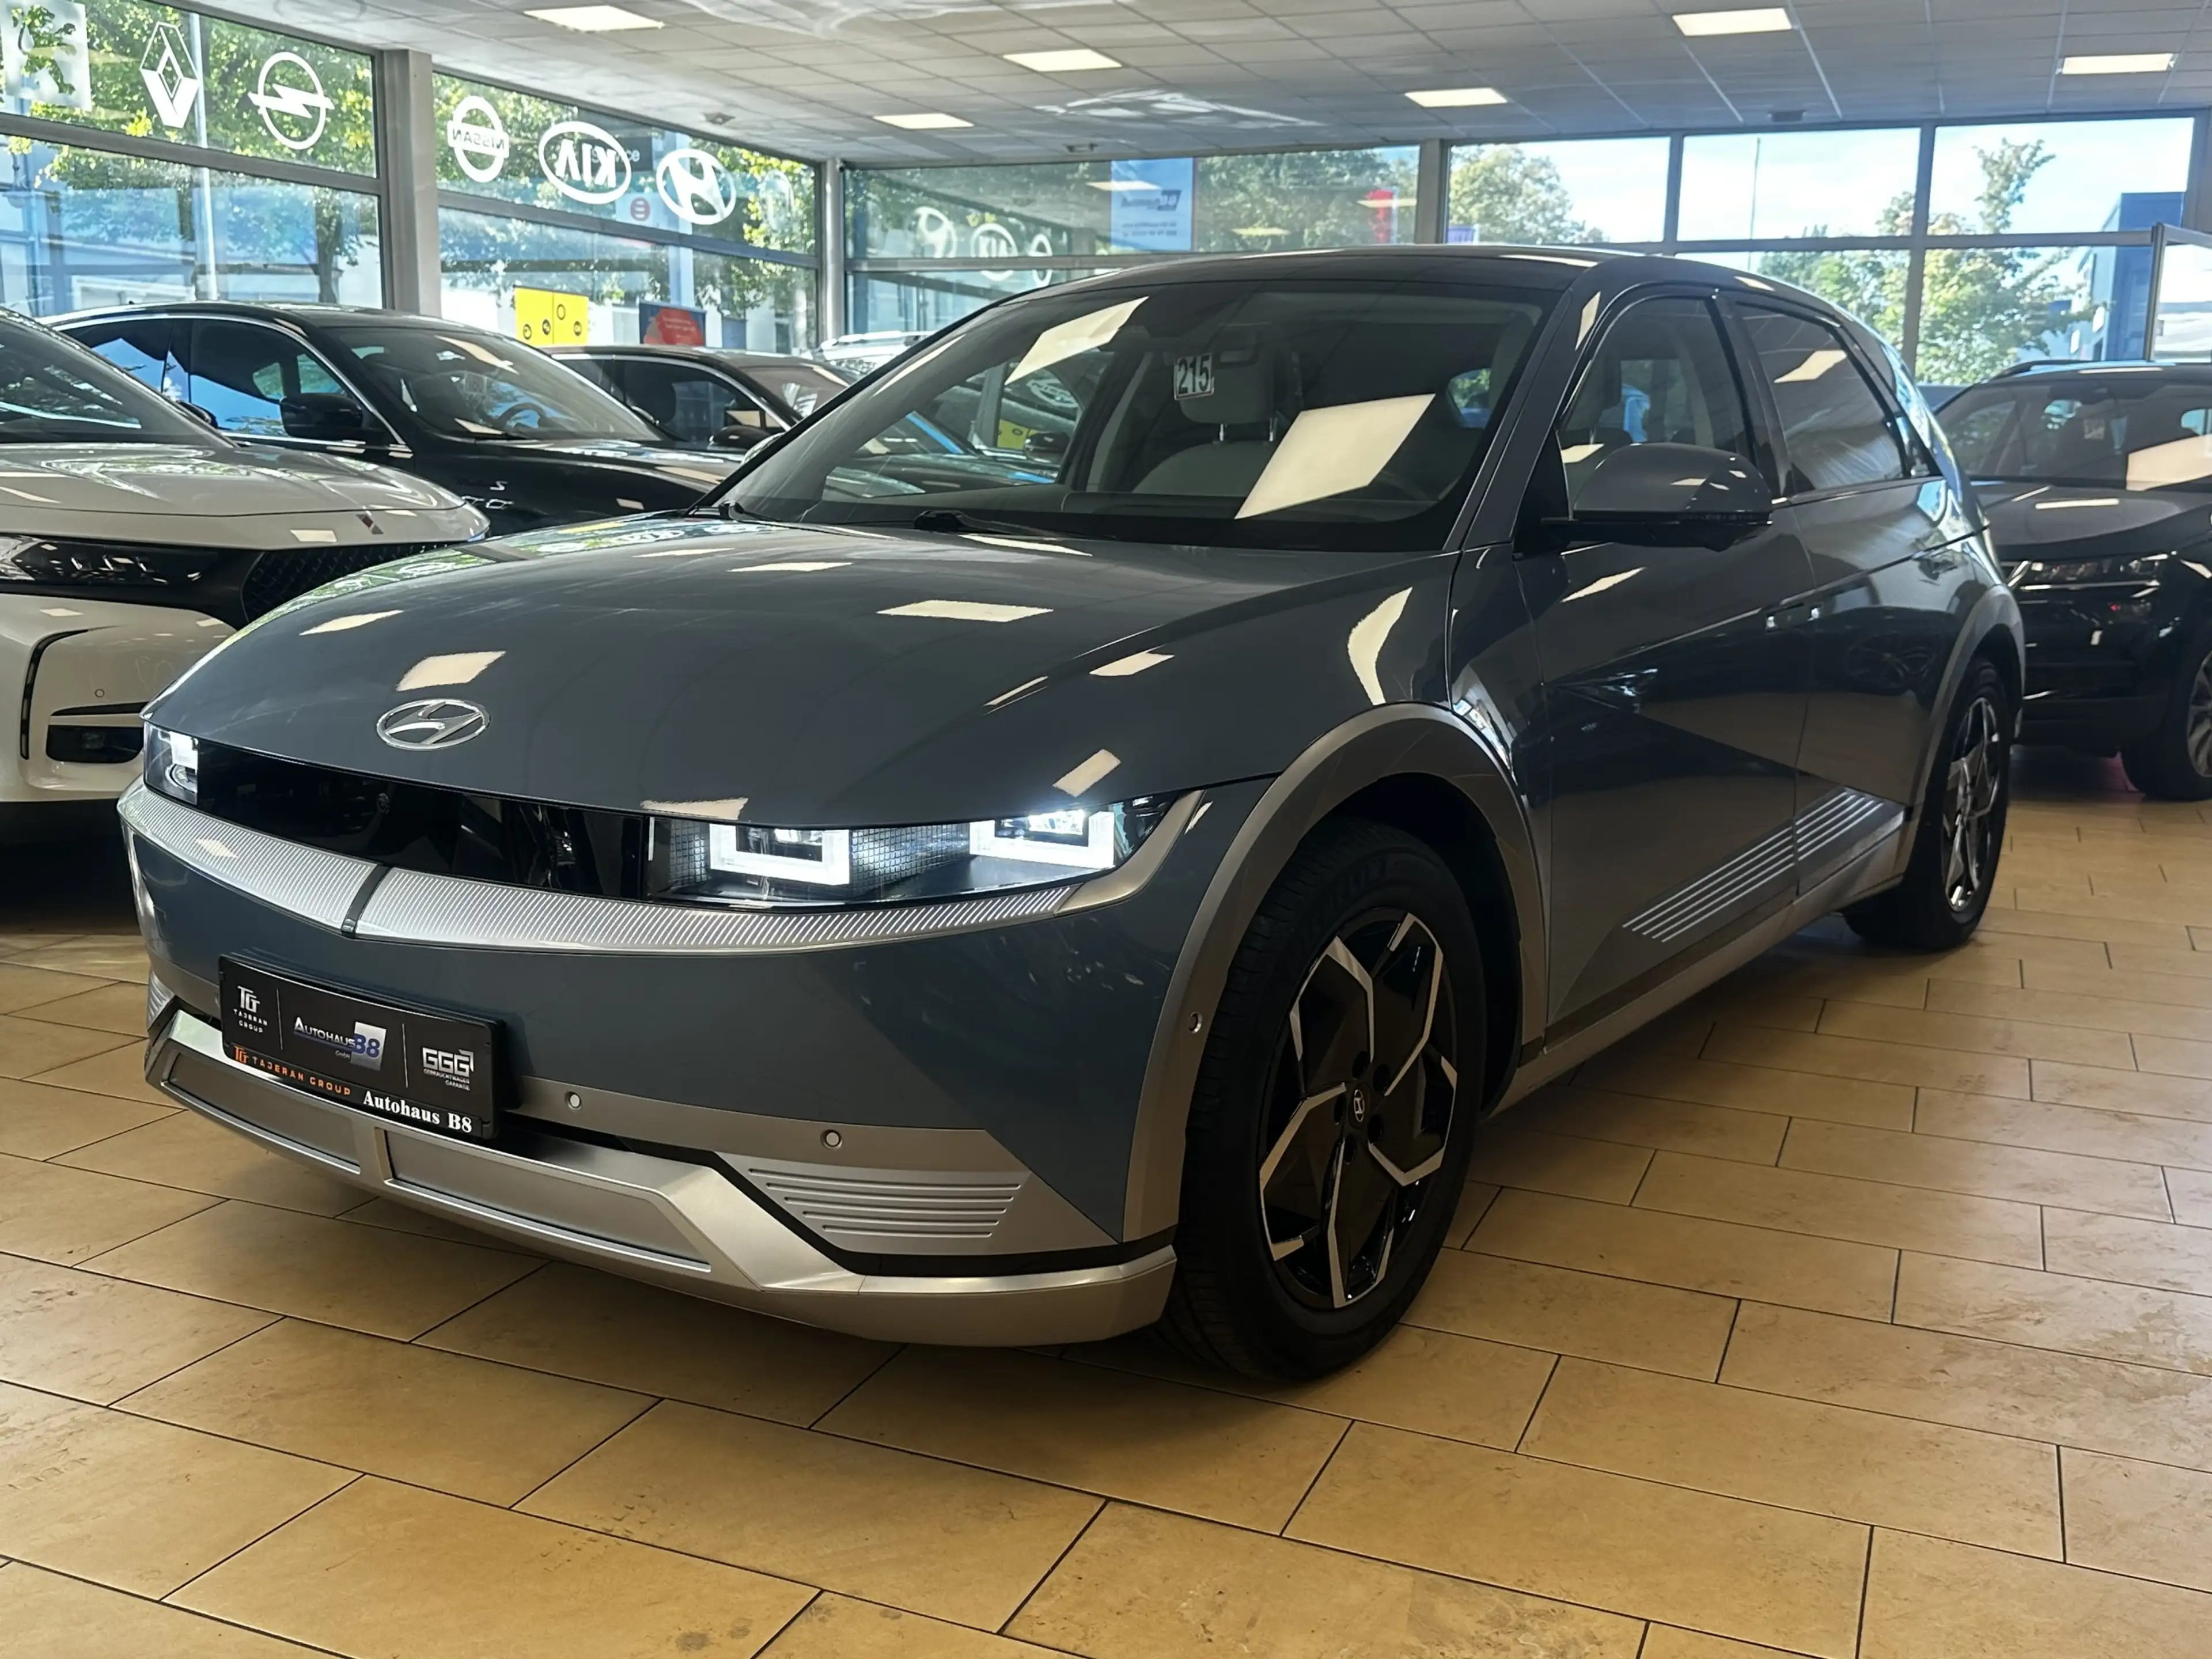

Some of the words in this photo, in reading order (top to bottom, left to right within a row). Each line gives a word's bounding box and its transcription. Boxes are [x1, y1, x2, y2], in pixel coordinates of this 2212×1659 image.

[1178, 354, 1210, 395] 215
[233, 1009, 268, 1026] TAJERAN
[238, 1020, 263, 1033] GROUP
[353, 1033, 380, 1058] B8
[252, 1056, 304, 1081] TAJERAN
[309, 1076, 351, 1096] GROUP
[363, 1090, 441, 1125] Autohaus
[447, 1112, 472, 1134] B8
